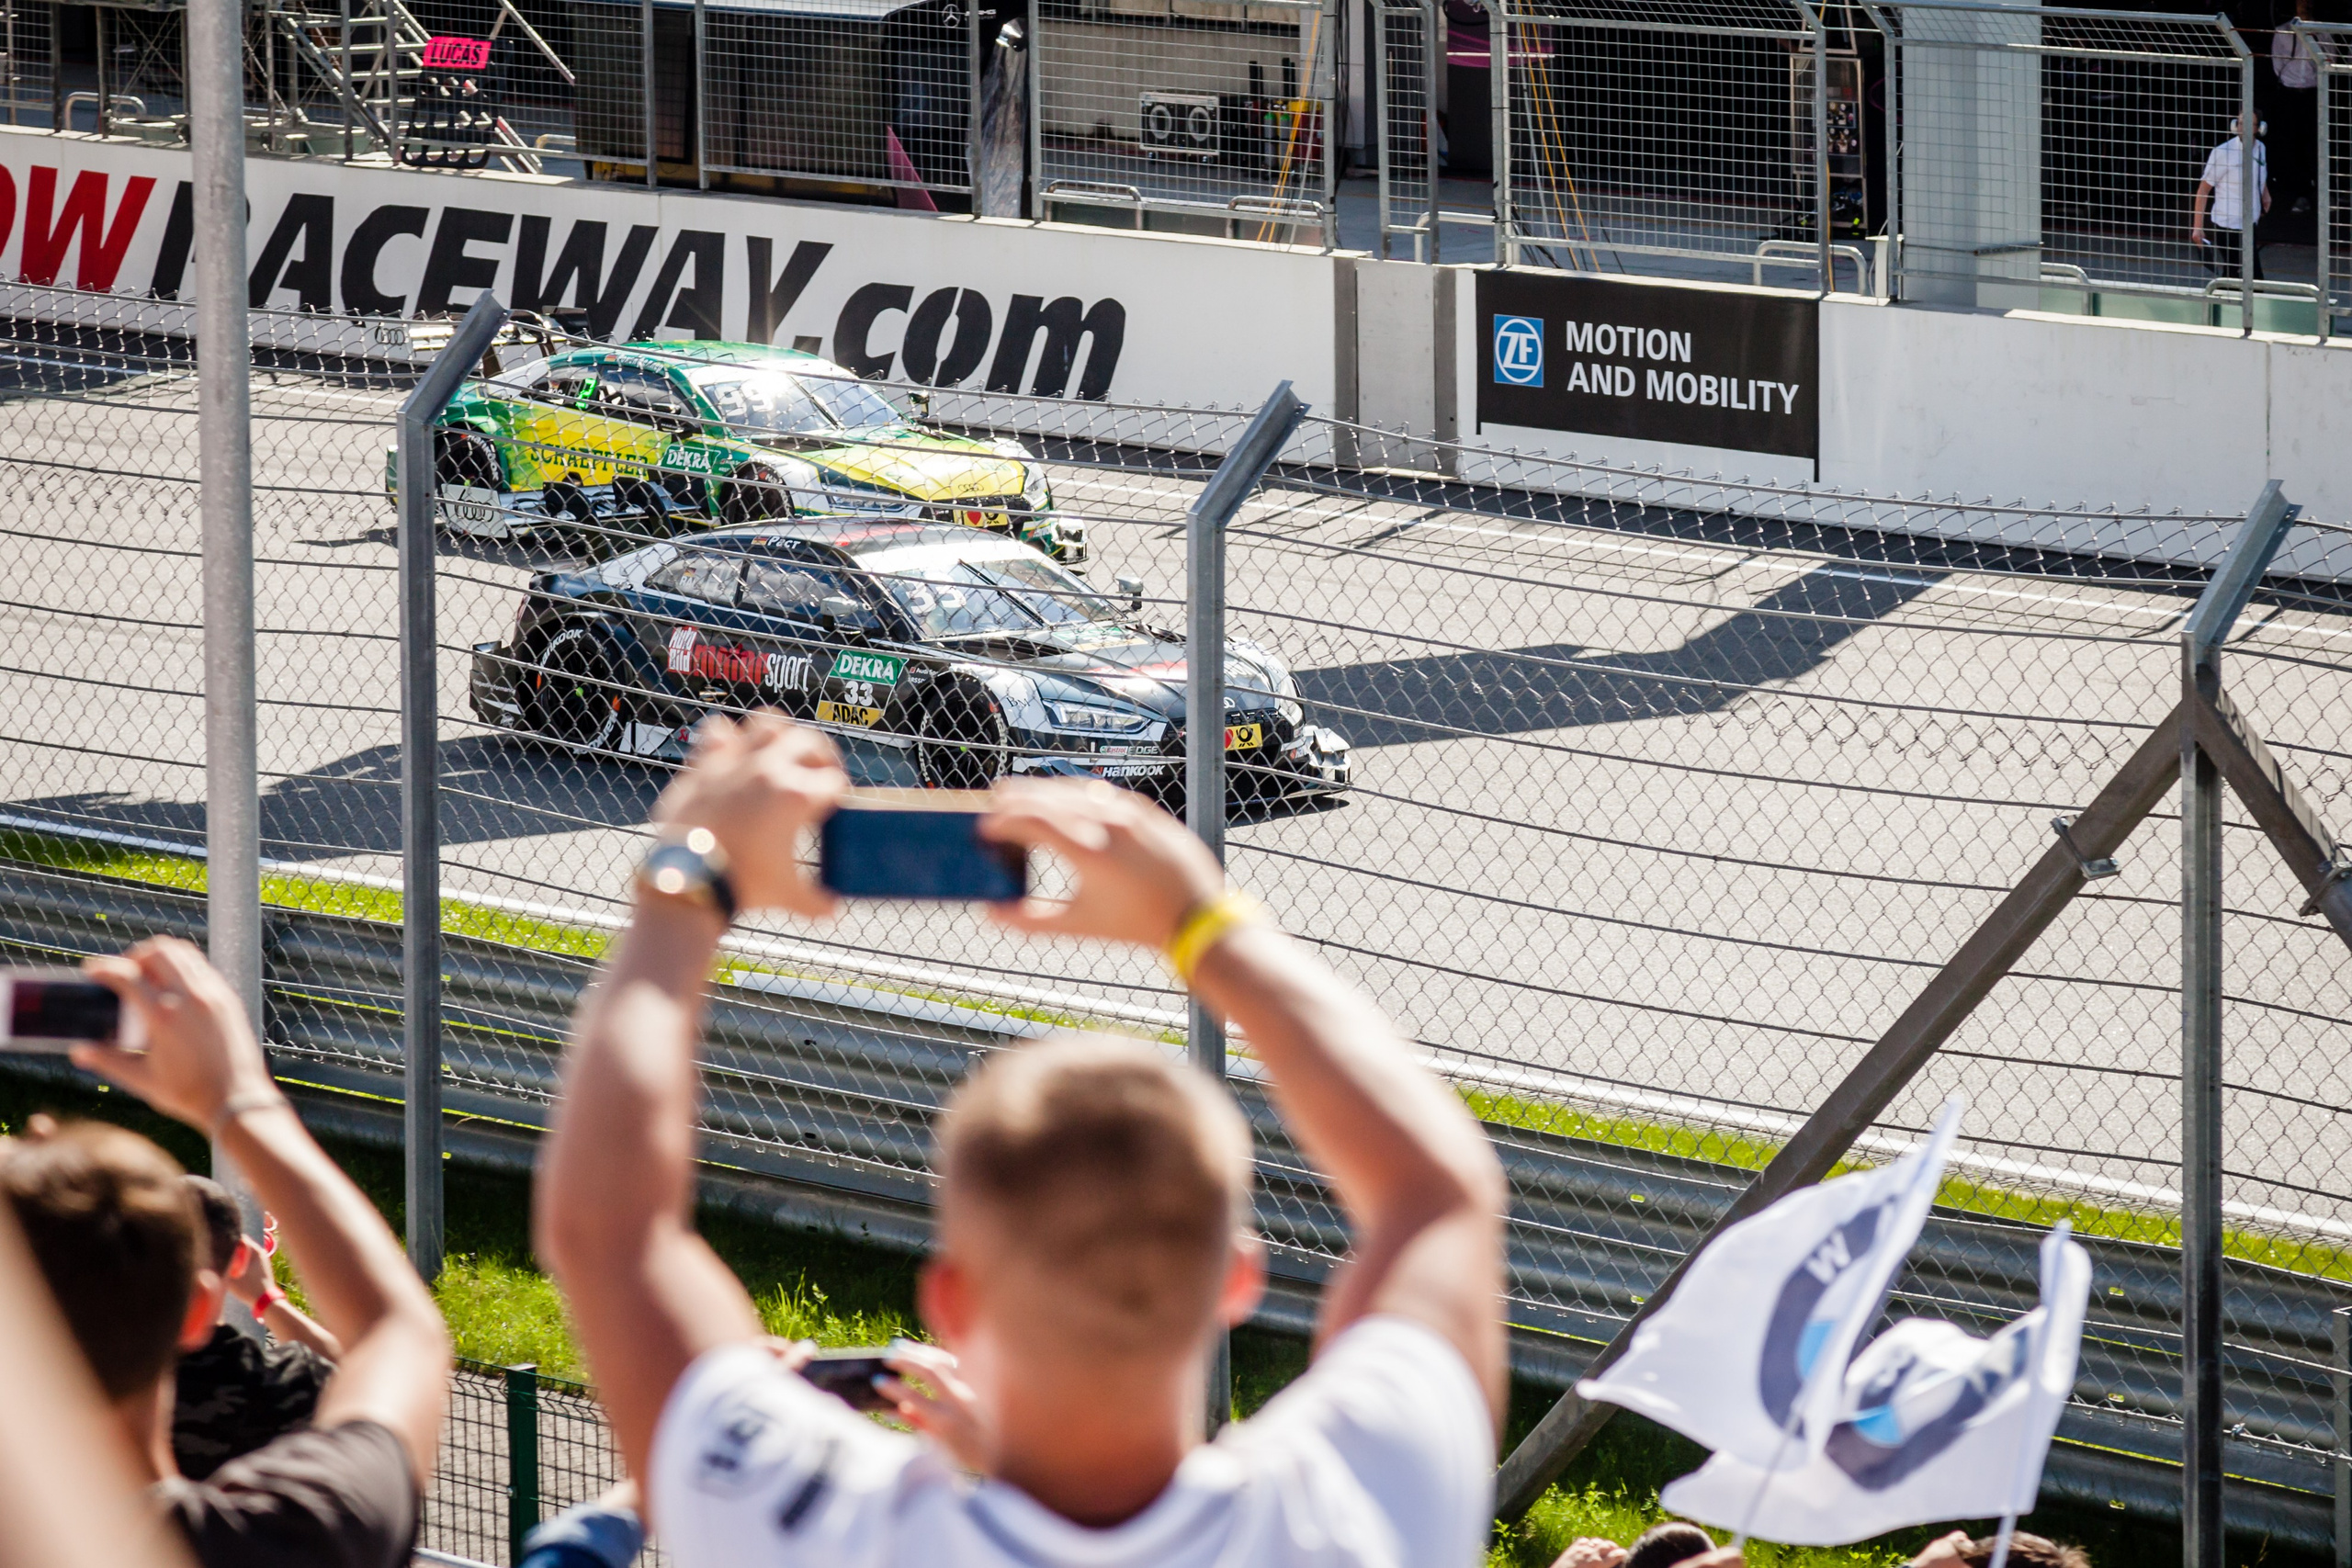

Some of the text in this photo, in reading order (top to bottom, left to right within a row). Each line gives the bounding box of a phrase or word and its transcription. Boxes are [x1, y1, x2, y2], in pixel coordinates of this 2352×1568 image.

[430, 42, 483, 65] LUCAS
[0, 164, 157, 294] W
[1498, 326, 1540, 373] ZF
[1566, 321, 1691, 363] MOTION
[1567, 362, 1799, 414] AND MOBILITY
[531, 441, 649, 477] SCHAEFFLER
[666, 448, 711, 470] DEKRA
[839, 653, 895, 681] DEKRA
[844, 681, 874, 706] 33
[832, 705, 868, 728] ADAC
[1127, 745, 1159, 755] EDGE
